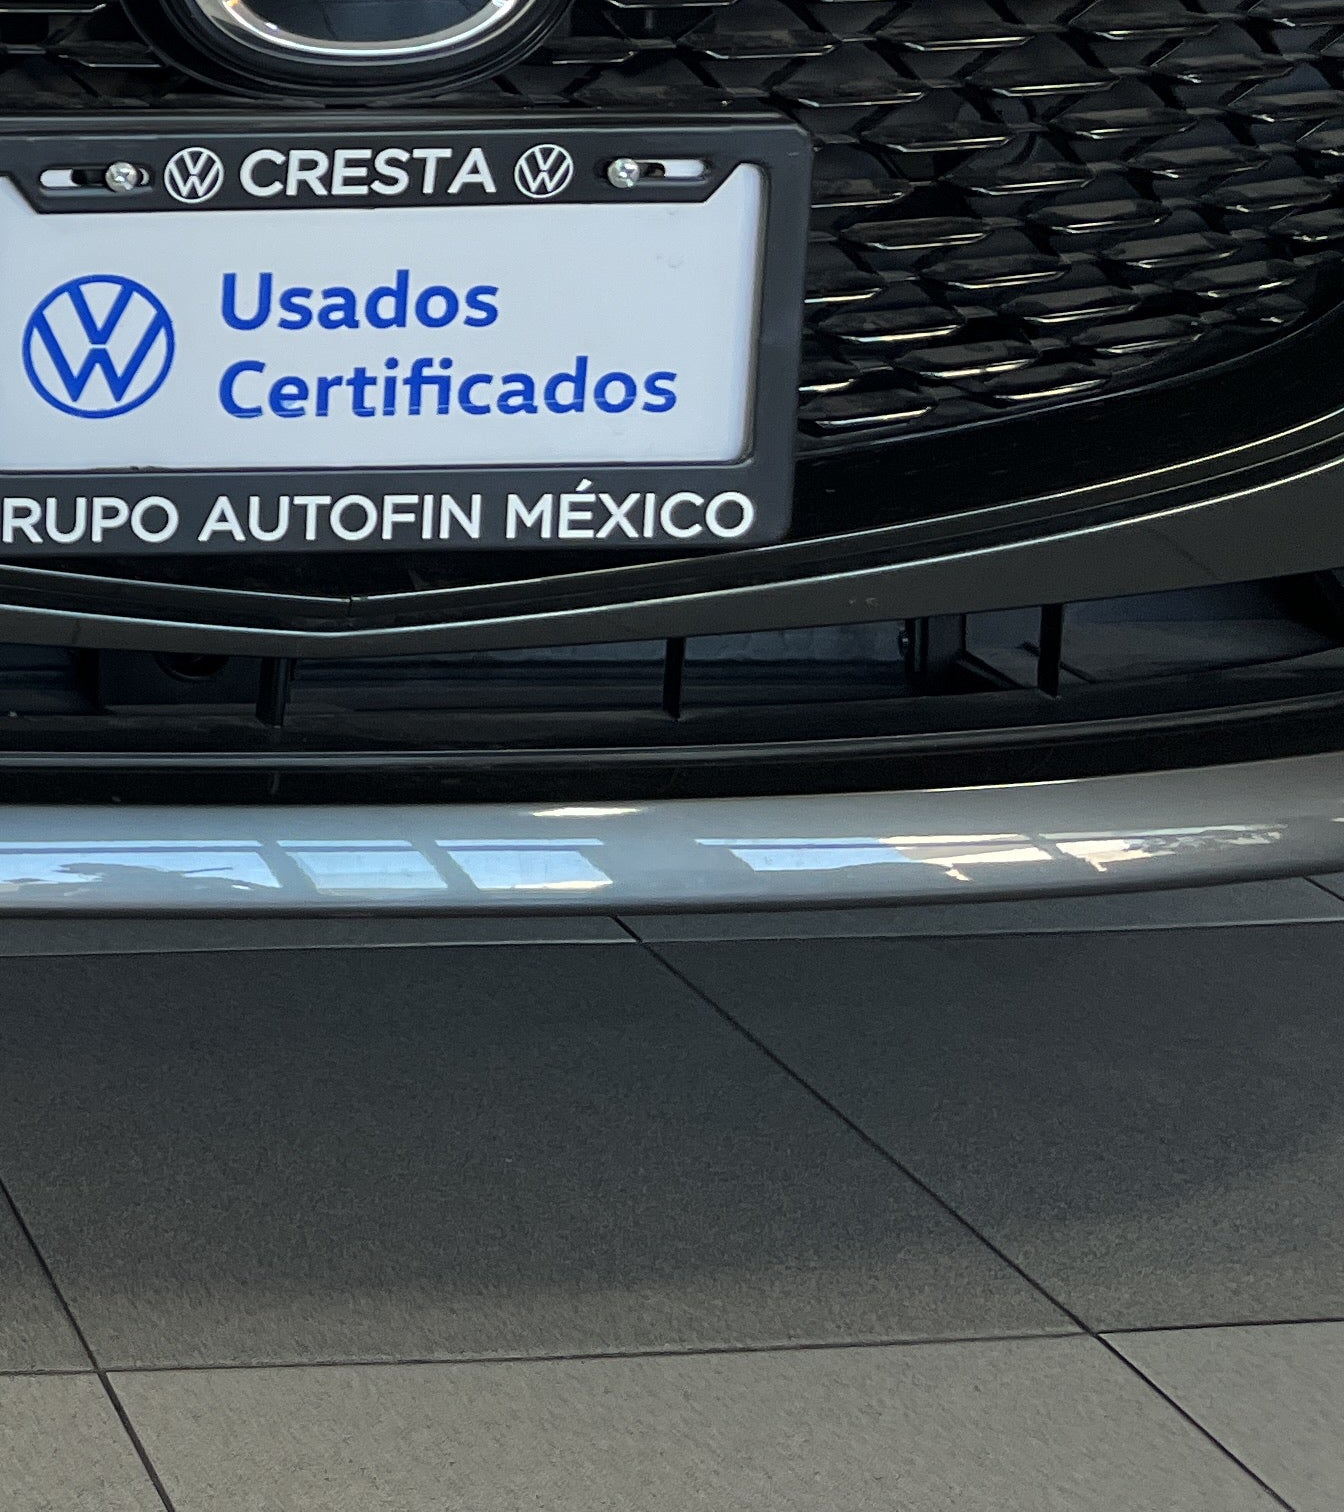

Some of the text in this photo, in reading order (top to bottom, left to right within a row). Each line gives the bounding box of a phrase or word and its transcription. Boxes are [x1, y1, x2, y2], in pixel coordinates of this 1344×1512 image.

[239, 146, 497, 198] CRESTA
[220, 268, 500, 331] Usados
[218, 354, 679, 419] Certificados
[196, 493, 483, 543] AUTOFIN
[504, 477, 756, 541] MÉXICO
